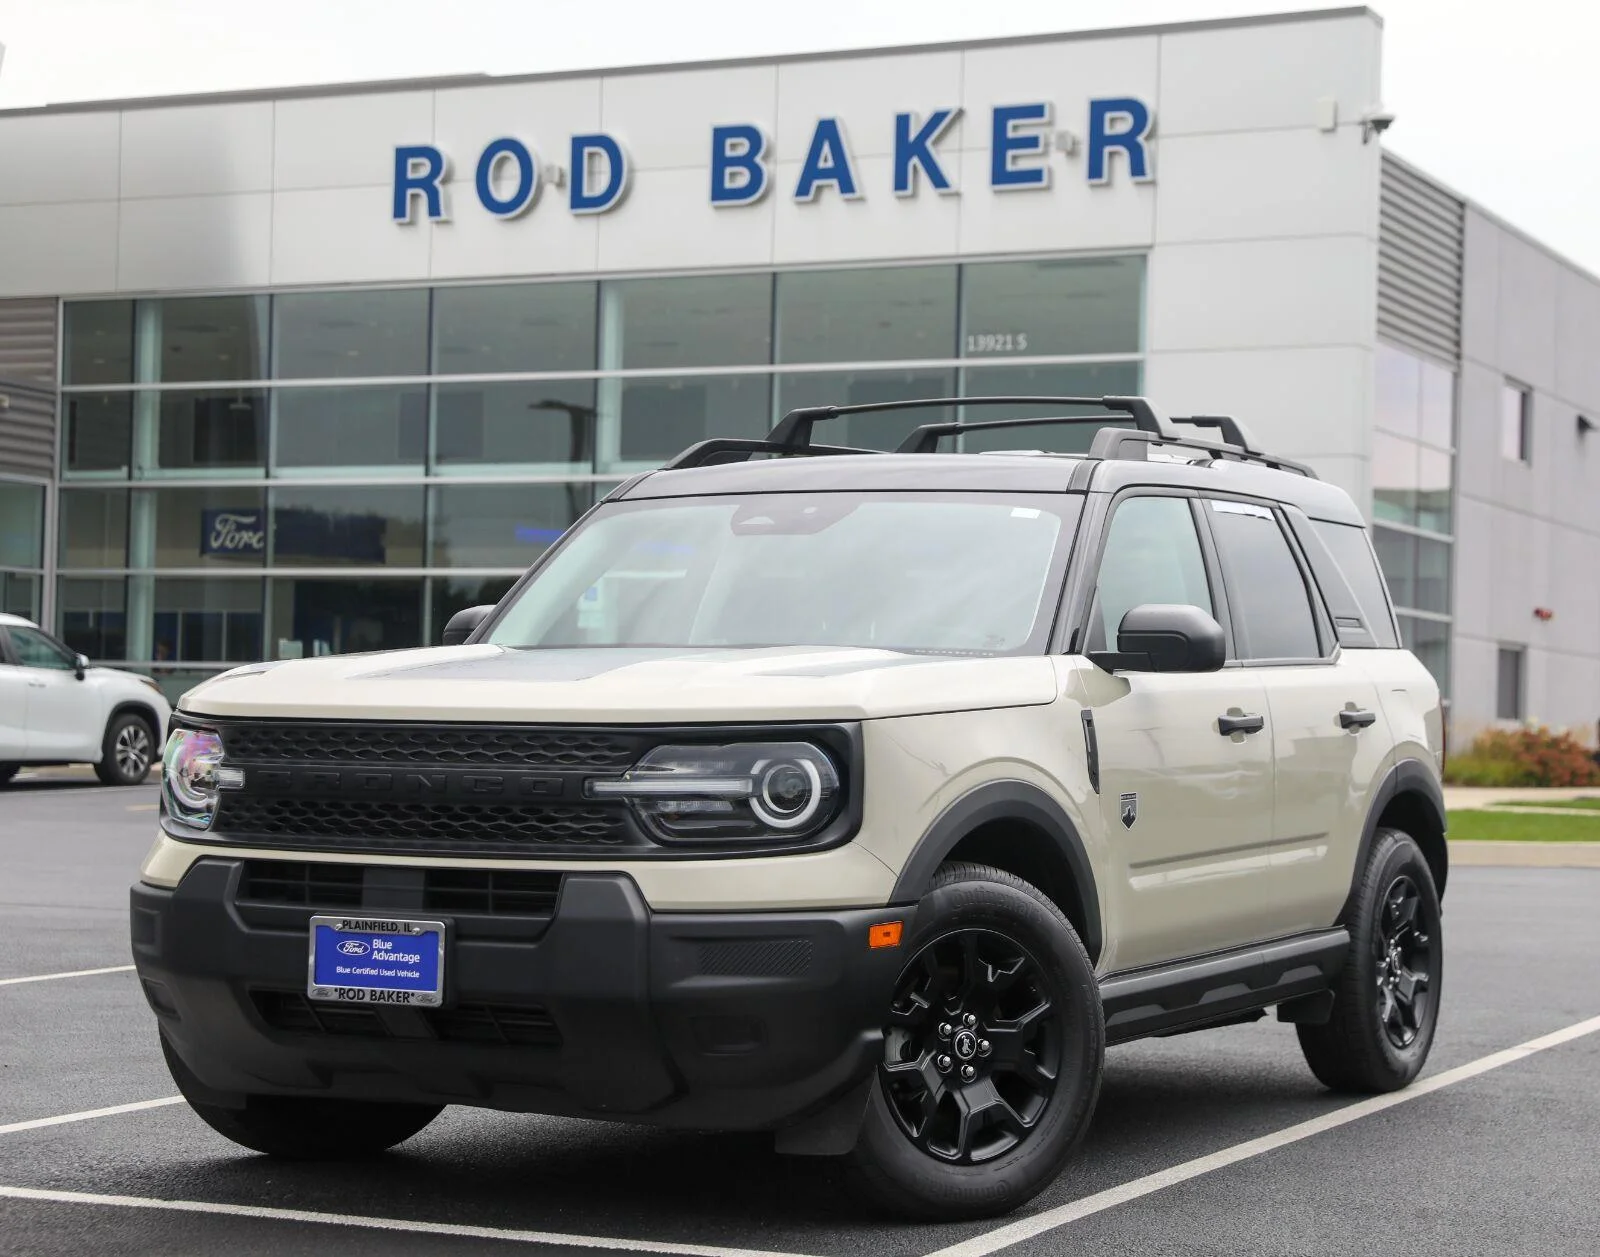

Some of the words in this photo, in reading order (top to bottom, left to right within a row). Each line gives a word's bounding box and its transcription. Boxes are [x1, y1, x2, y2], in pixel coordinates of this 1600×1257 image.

[392, 132, 630, 223] ROD
[710, 97, 1154, 206] BAKER
[968, 334, 1013, 352] 13921
[1016, 332, 1027, 351] S
[256, 769, 564, 797] BRONCO
[342, 920, 400, 933] PLAINFIELD,
[403, 922, 412, 932] IL
[343, 942, 365, 954] Ford
[372, 939, 393, 950] Blue
[372, 950, 420, 965] Advantage
[336, 966, 351, 974] Blue
[352, 967, 379, 976] Certified
[380, 968, 396, 977] Used
[397, 969, 420, 978] Vehicle
